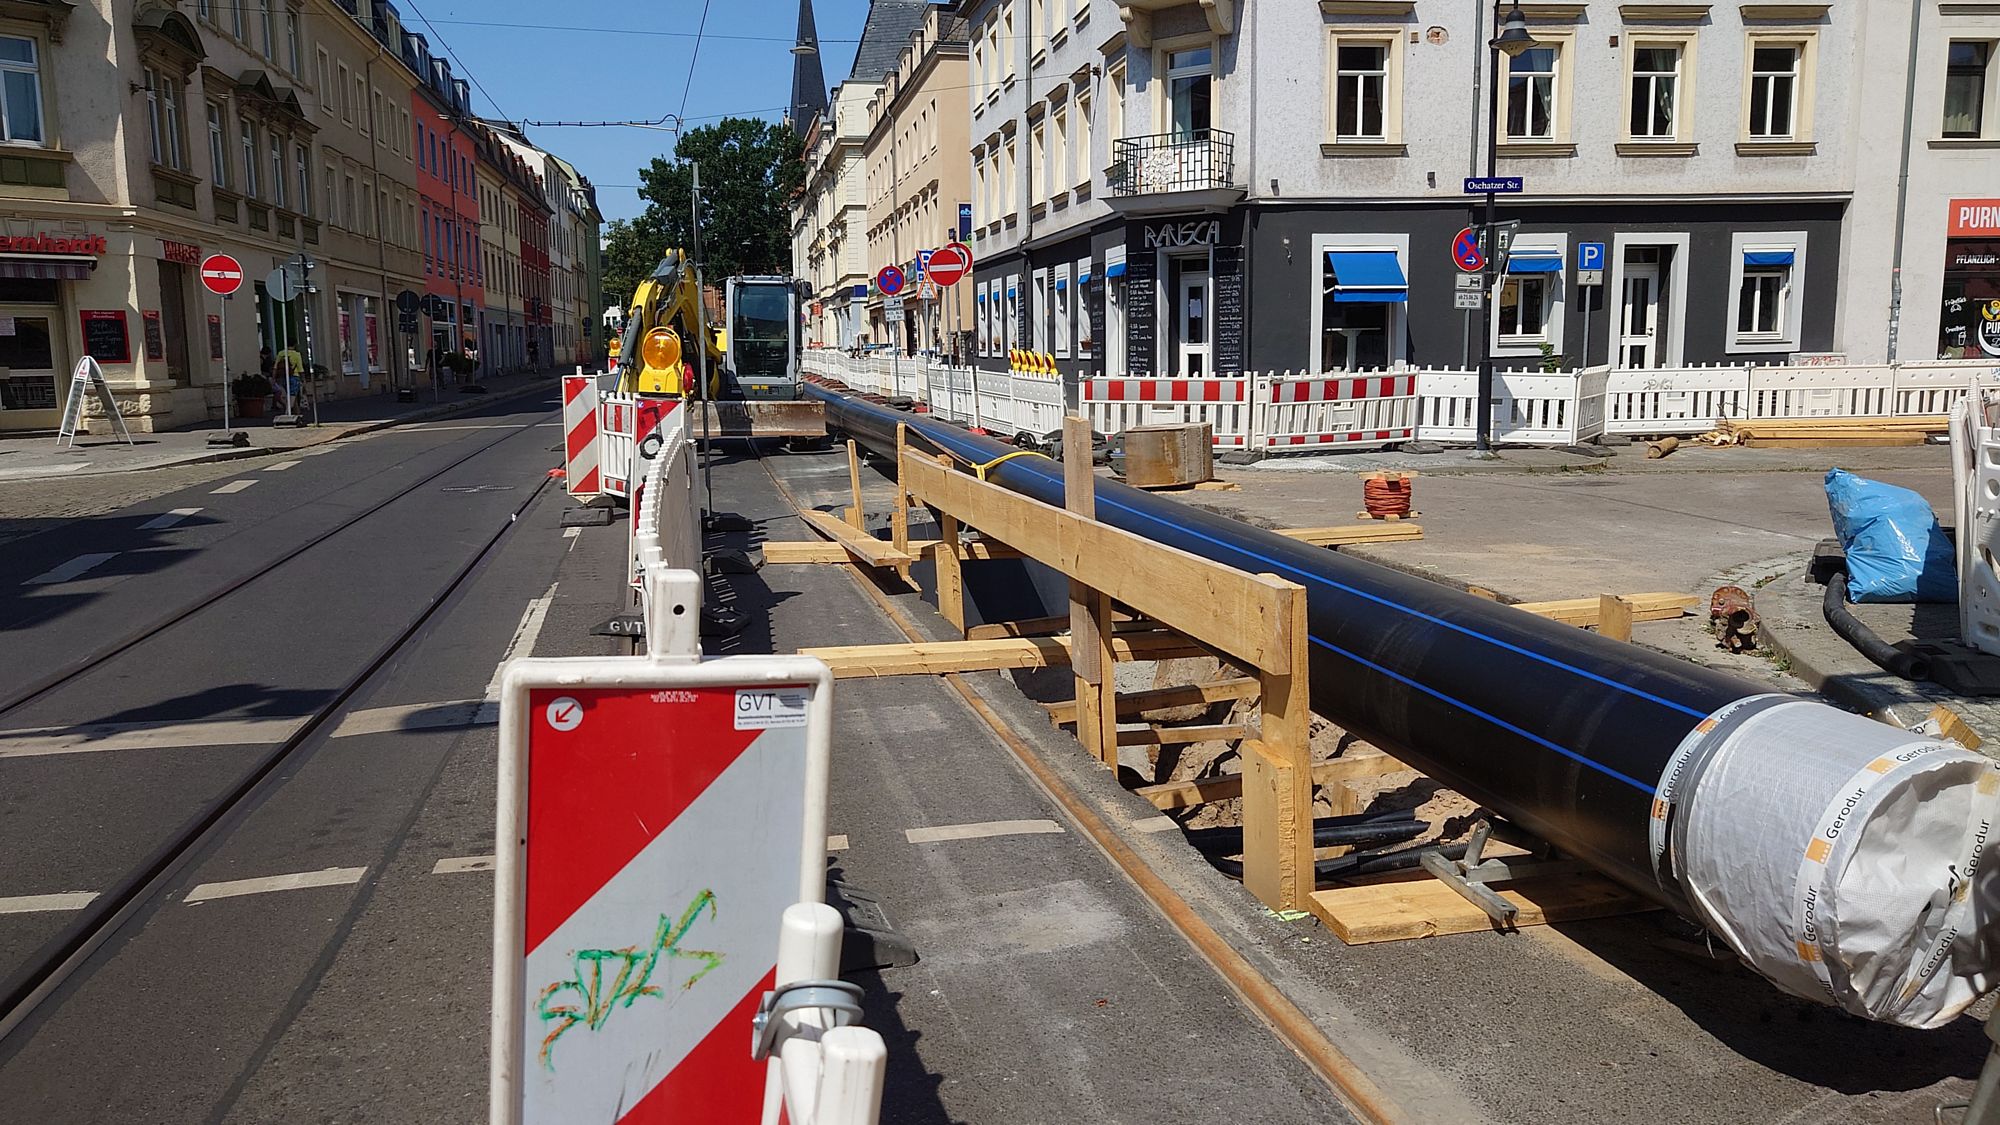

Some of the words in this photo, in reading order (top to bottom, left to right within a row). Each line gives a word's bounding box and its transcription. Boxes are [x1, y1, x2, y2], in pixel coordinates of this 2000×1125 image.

[1467, 181, 1505, 190] Oschatzer
[1506, 180, 1520, 190] Str.
[1584, 246, 1599, 267] P
[610, 621, 643, 634] GVT
[738, 693, 776, 711] GVT
[1663, 748, 1693, 798] Gerodur
[1826, 786, 1867, 840] Gerodur
[1963, 818, 1990, 878] Gerodur
[1803, 885, 1818, 943] Gerodur
[1919, 925, 1960, 978] Gerodur
